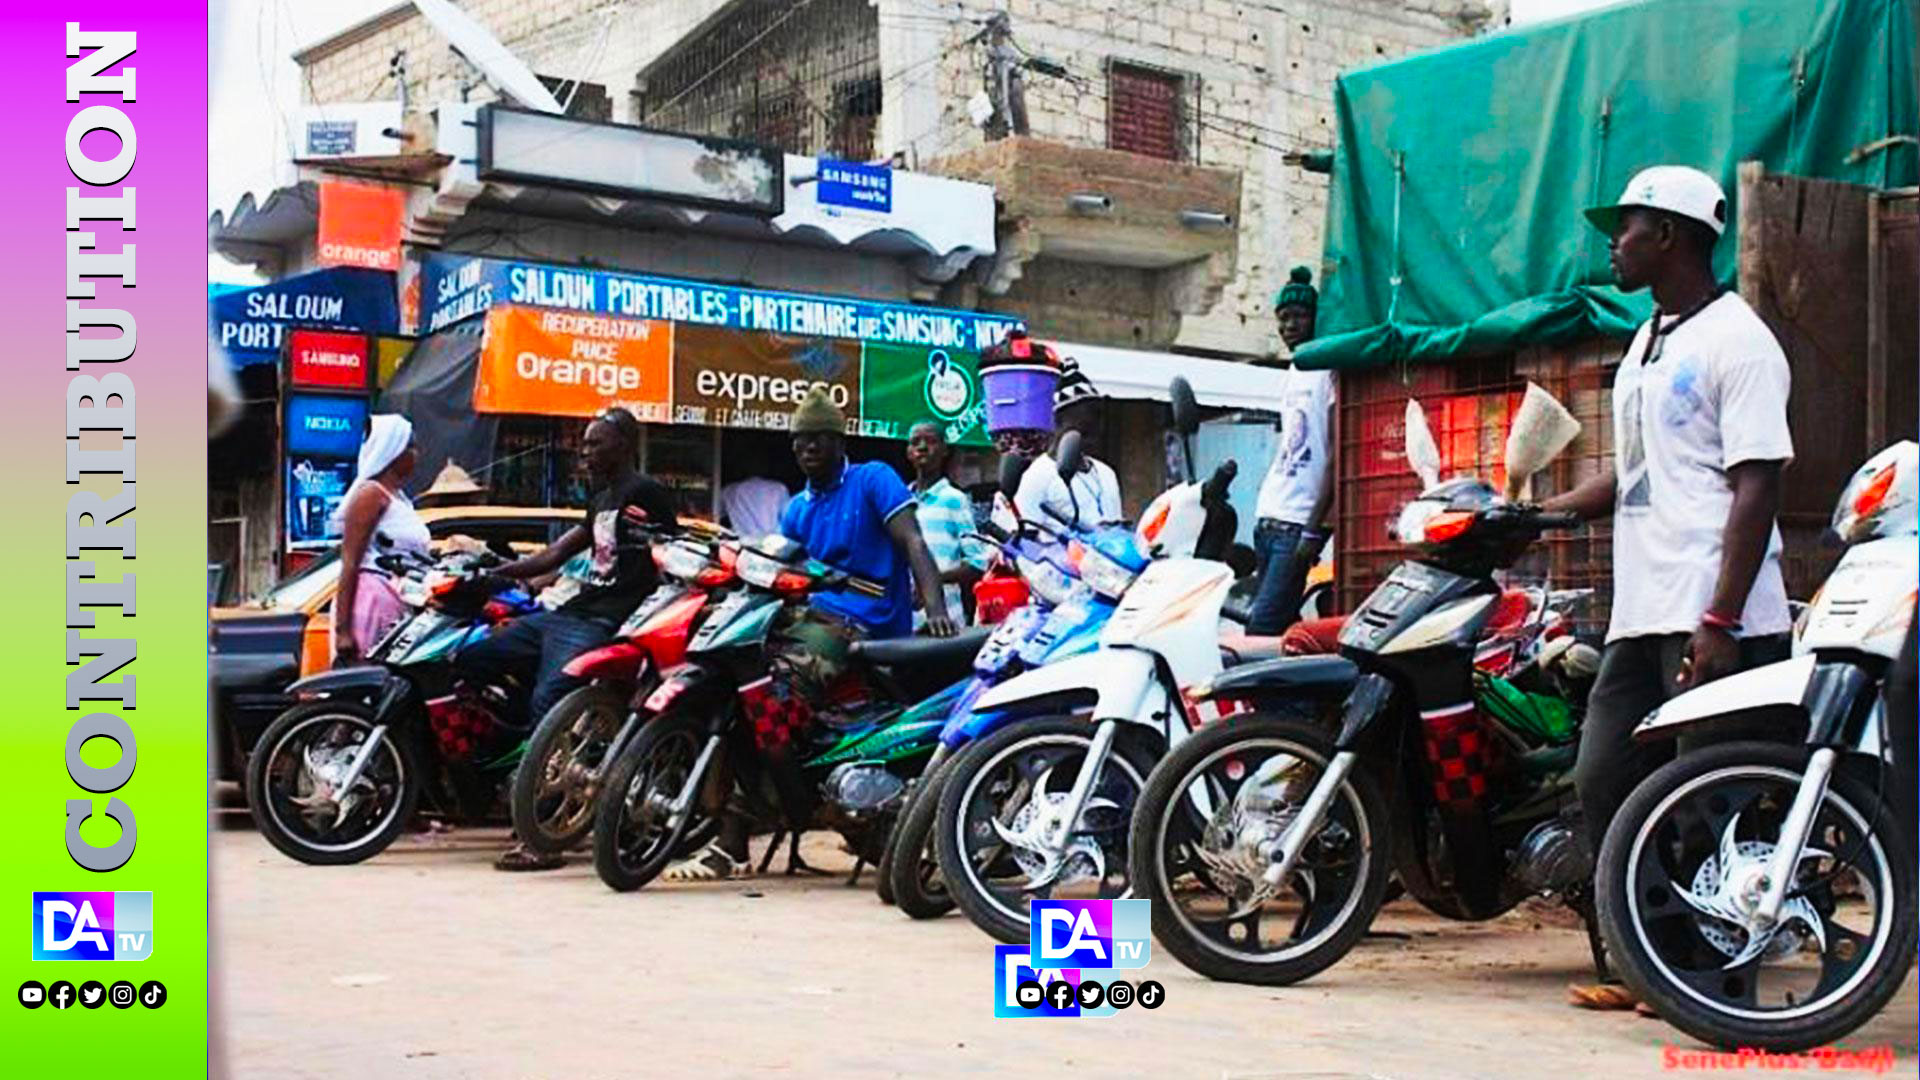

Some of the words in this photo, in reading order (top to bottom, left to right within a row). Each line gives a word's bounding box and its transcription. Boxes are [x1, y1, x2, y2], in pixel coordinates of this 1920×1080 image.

[320, 243, 391, 268] orange
[510, 267, 596, 312] SALOUM
[246, 292, 343, 321] SALOUM
[304, 415, 352, 432] NOKIA
